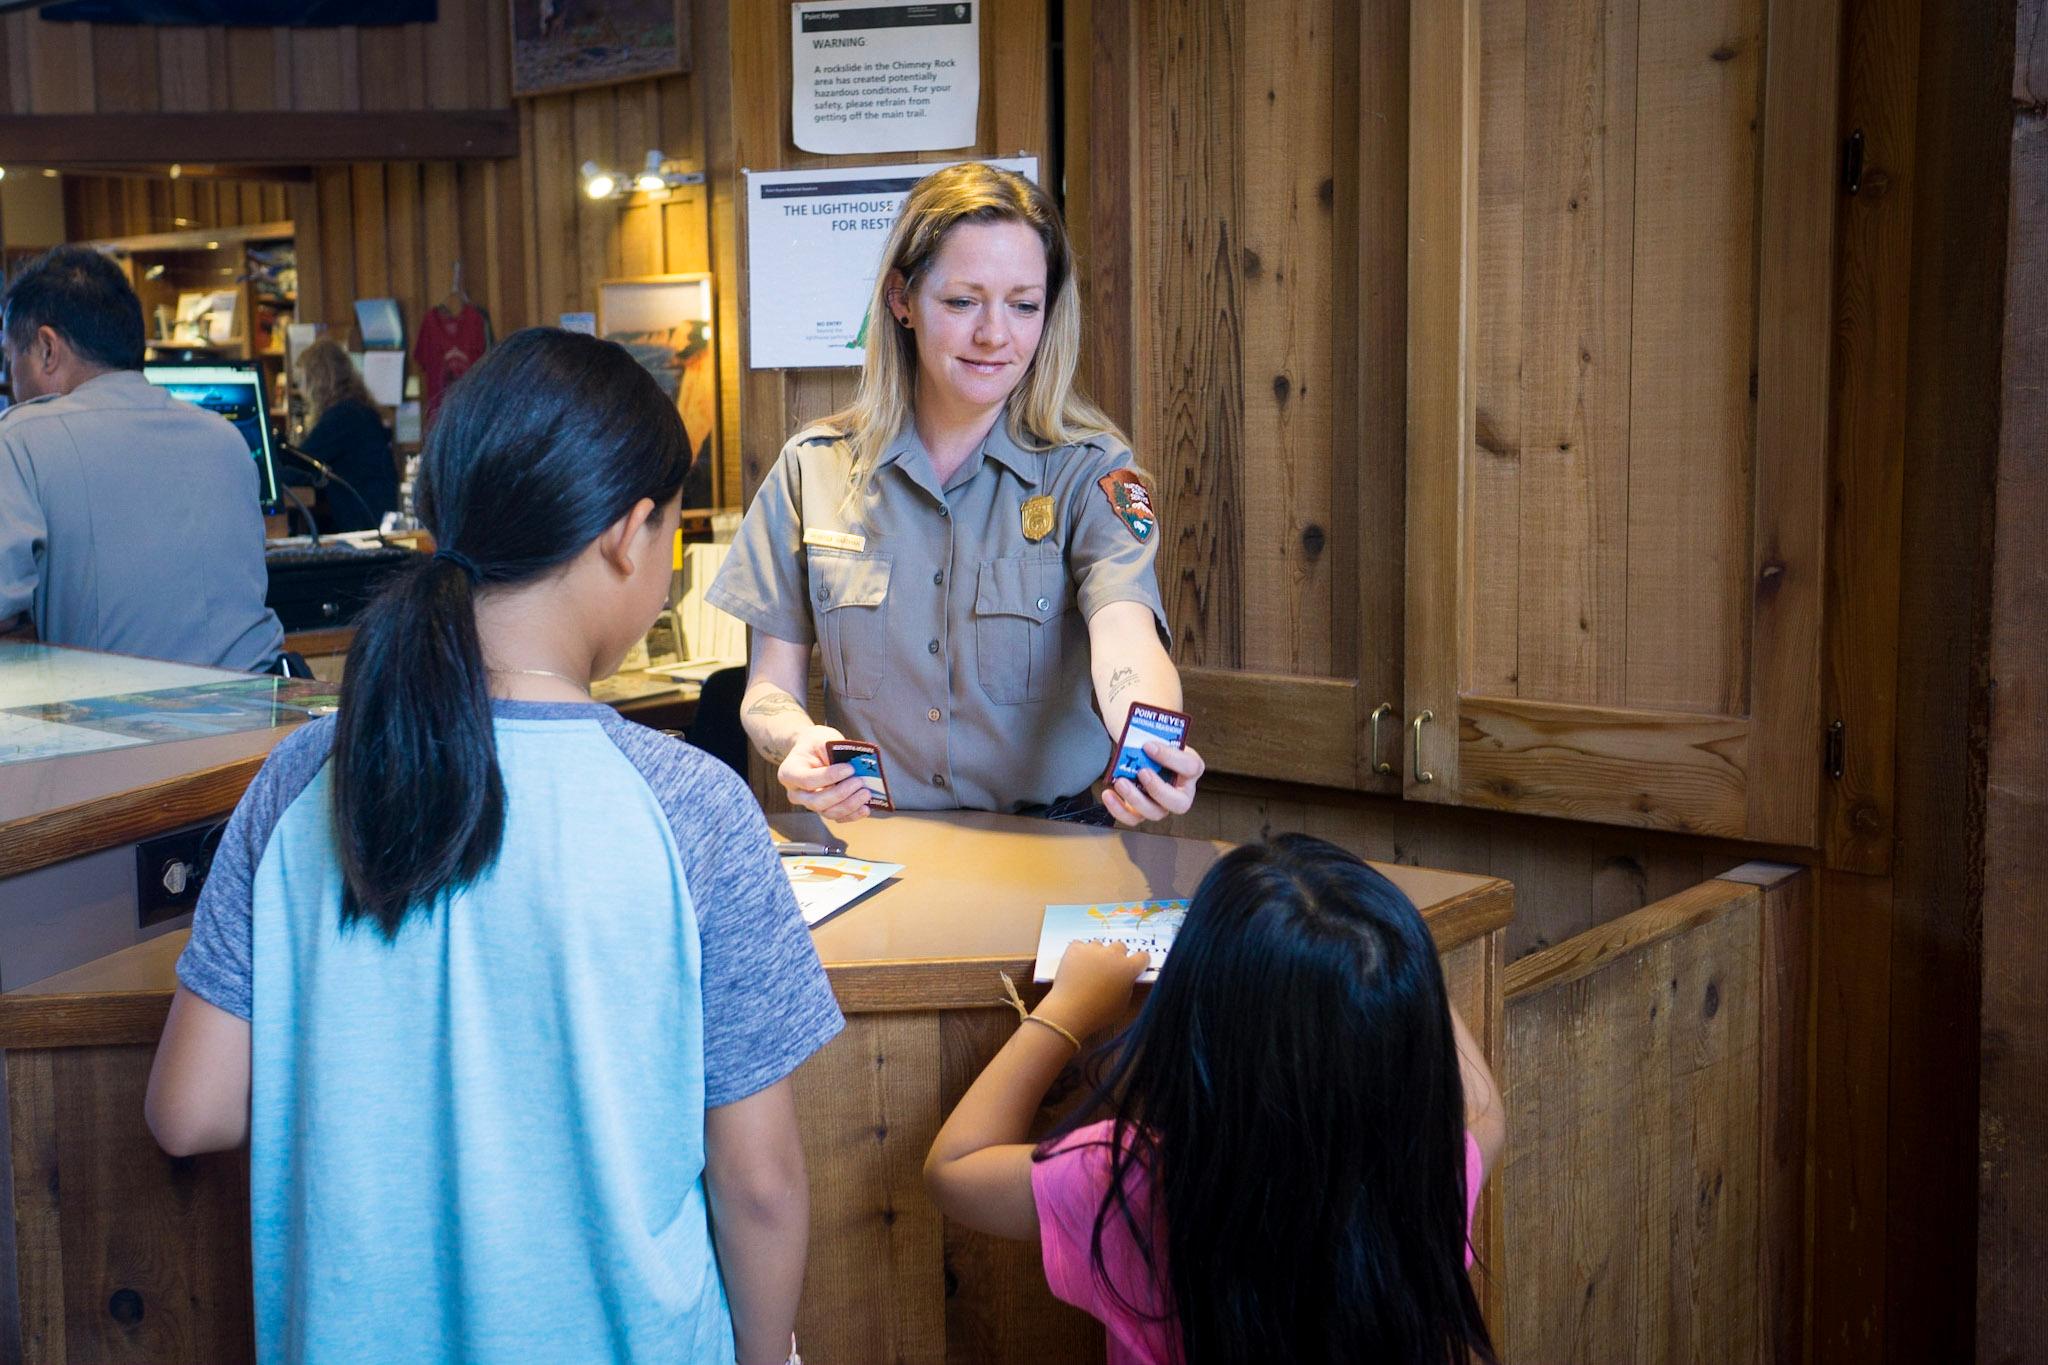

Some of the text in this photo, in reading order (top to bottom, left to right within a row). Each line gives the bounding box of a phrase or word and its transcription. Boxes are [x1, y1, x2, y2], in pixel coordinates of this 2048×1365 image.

[813, 37, 865, 49] WARNING
[814, 59, 955, 73] A rockslide in the Chimney Rock
[814, 72, 937, 86] area has created potentially
[814, 84, 952, 97] hazardous conditions. For your
[814, 97, 931, 111] safety, please refrain from
[814, 109, 927, 123] getting off the main trail.
[784, 200, 893, 216] THE LIGHTHOUSE
[832, 219, 857, 231] FOR
[1134, 707, 1186, 728] POINT REYES
